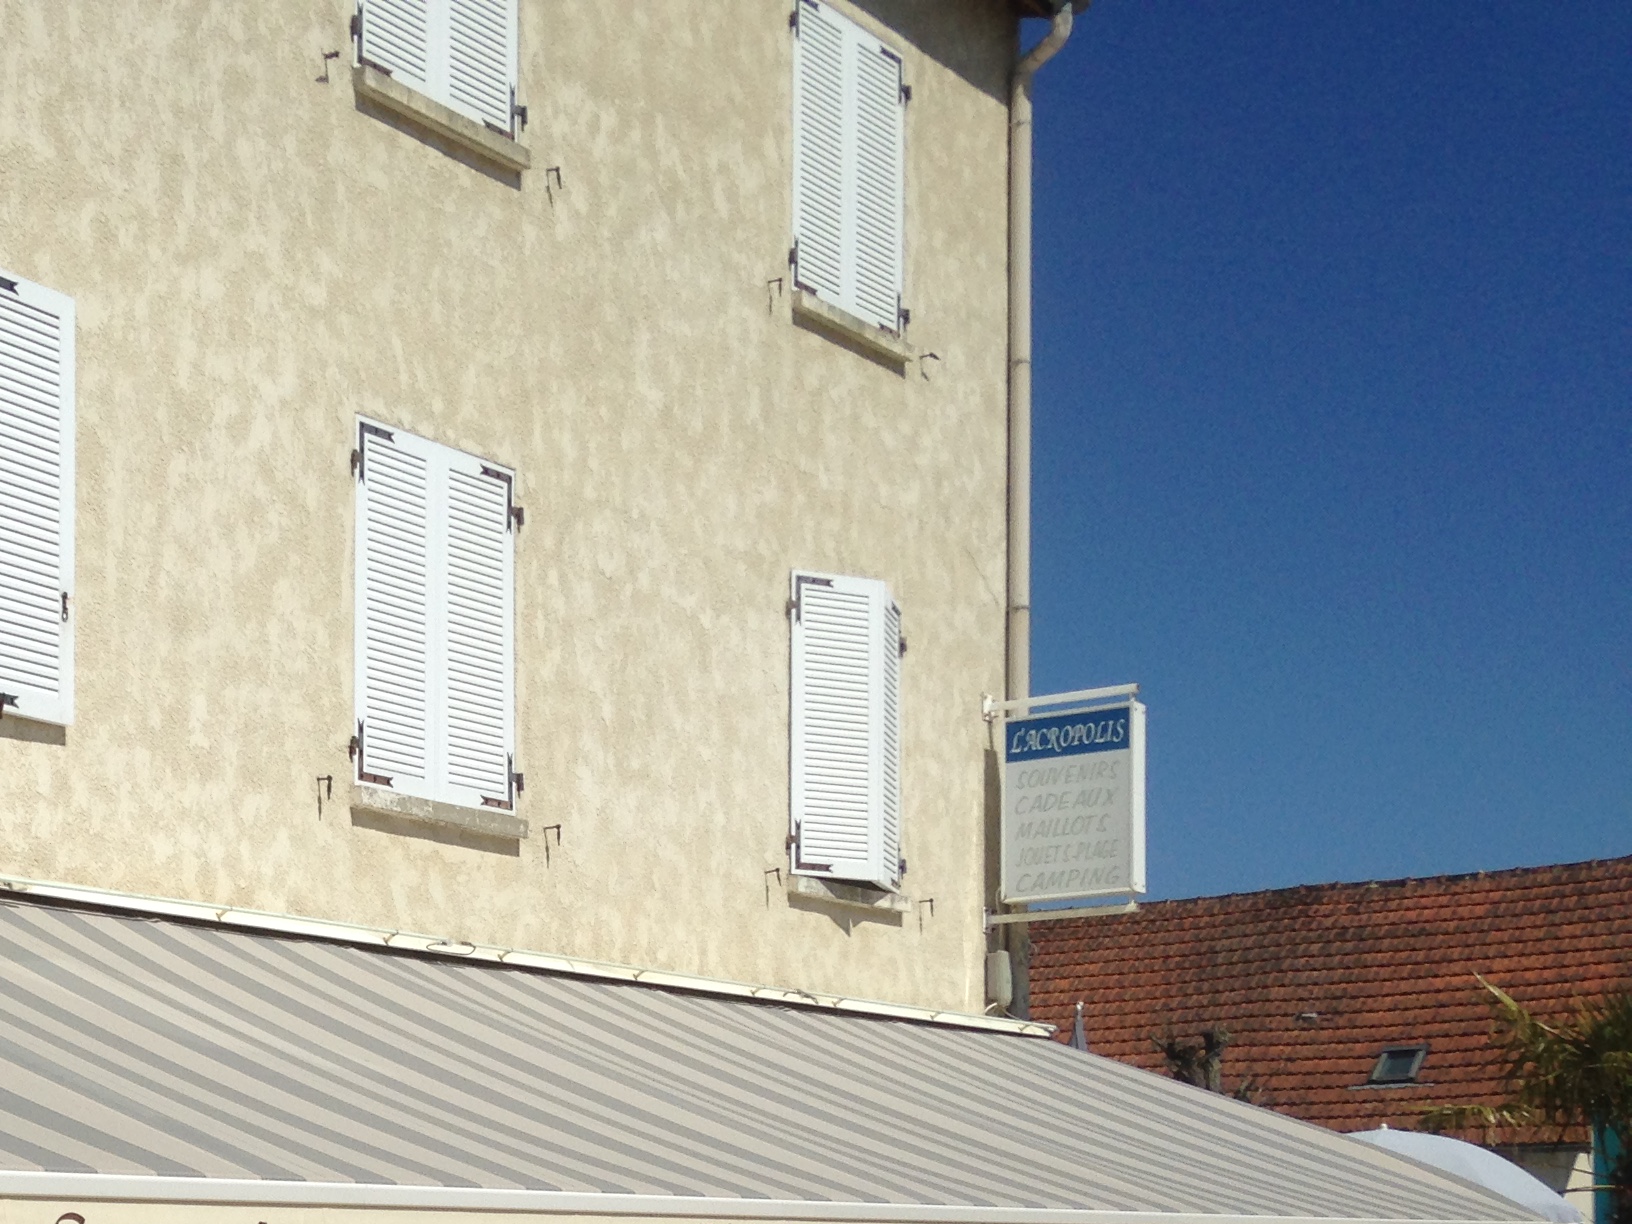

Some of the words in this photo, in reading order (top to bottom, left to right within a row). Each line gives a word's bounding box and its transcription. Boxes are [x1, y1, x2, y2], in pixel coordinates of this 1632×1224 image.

[1010, 718, 1125, 753] L'ACROPOLIS
[1015, 760, 1121, 790] SOUVENIRS
[1014, 787, 1117, 815] CADEAUX
[1014, 813, 1110, 841] MAILLOTS
[1016, 865, 1121, 892] CAMPING
